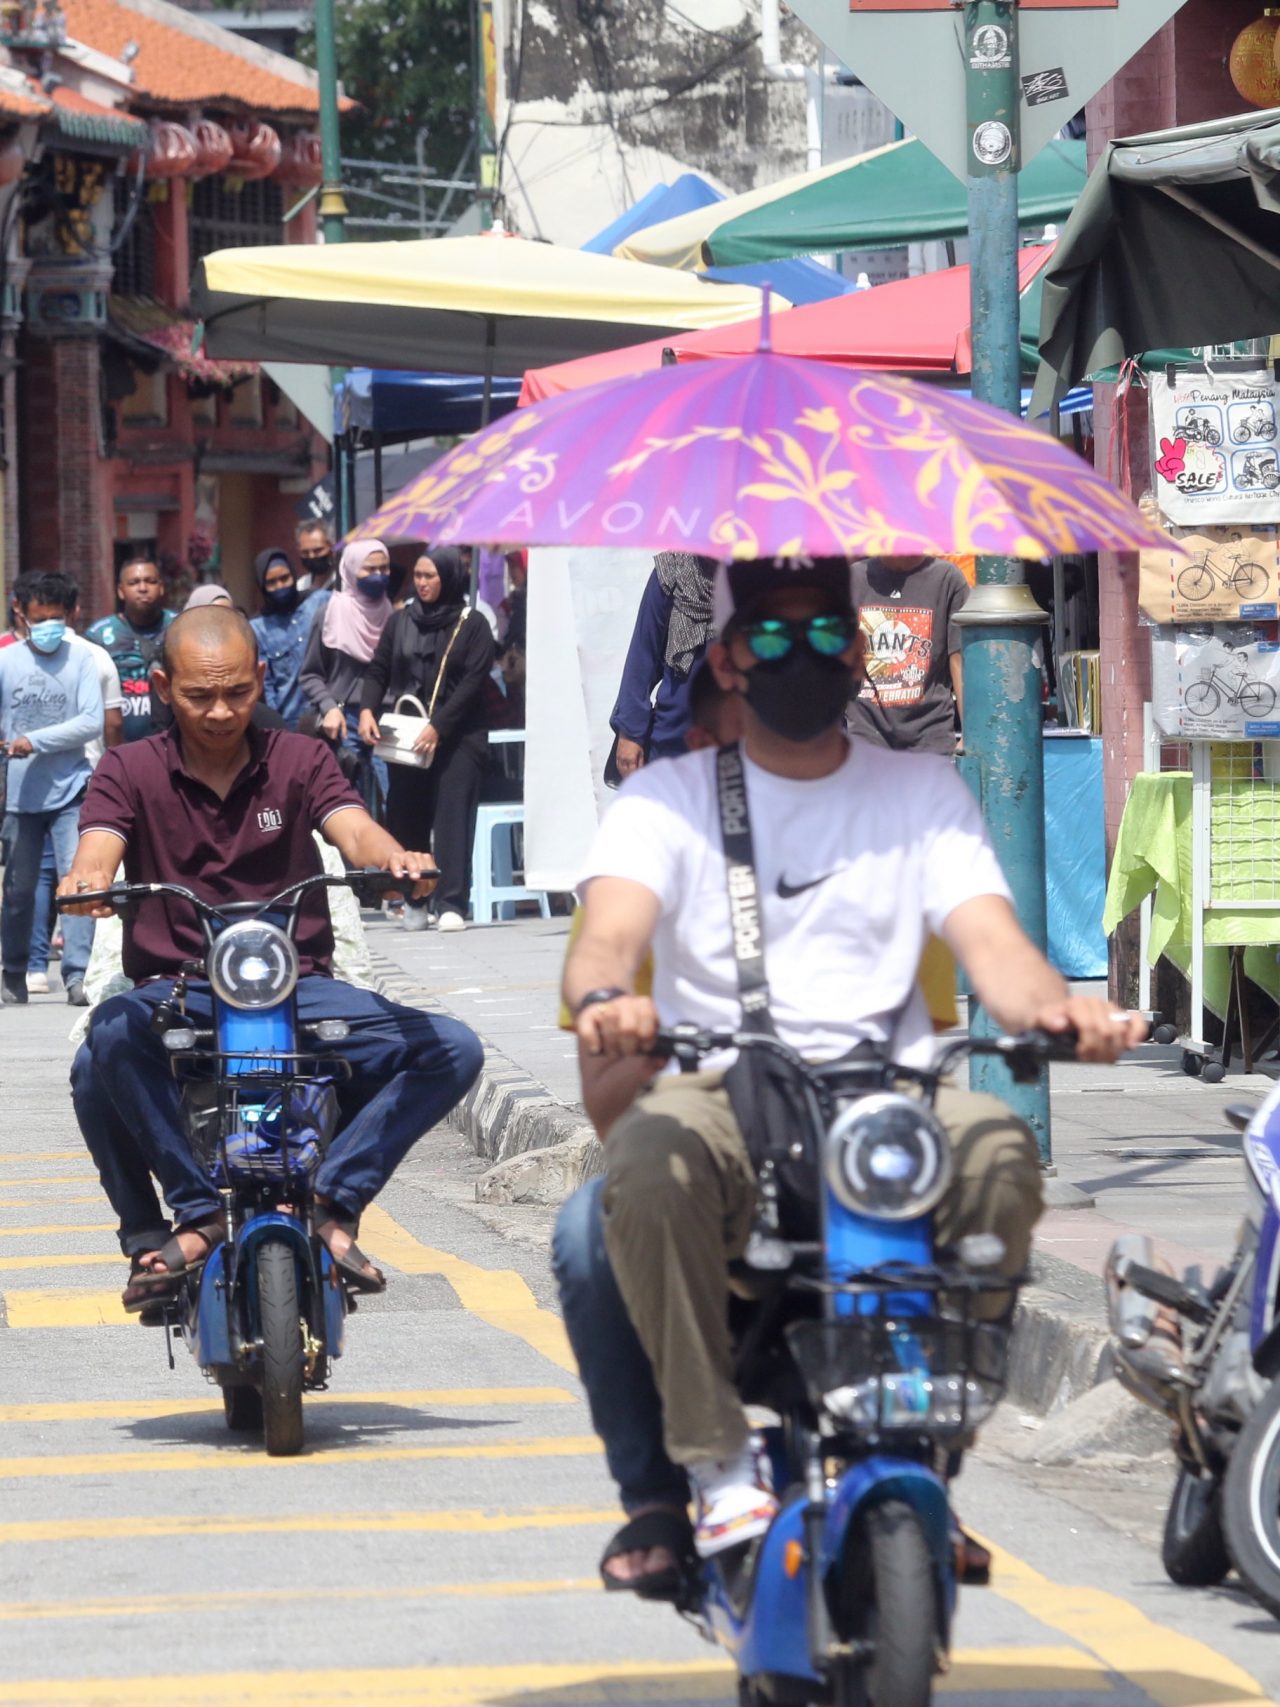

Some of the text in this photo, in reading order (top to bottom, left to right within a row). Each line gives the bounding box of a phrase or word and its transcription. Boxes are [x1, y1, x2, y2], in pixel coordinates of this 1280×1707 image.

[1190, 389, 1229, 405] Penang
[1232, 388, 1276, 404] Malaysia
[1177, 472, 1217, 485] SALE
[498, 500, 702, 538] AVON
[868, 632, 933, 659] IANTS
[11, 687, 67, 711] Surfing
[130, 695, 152, 716] YA
[719, 751, 748, 836] PORTER
[728, 865, 761, 961] PORTER
